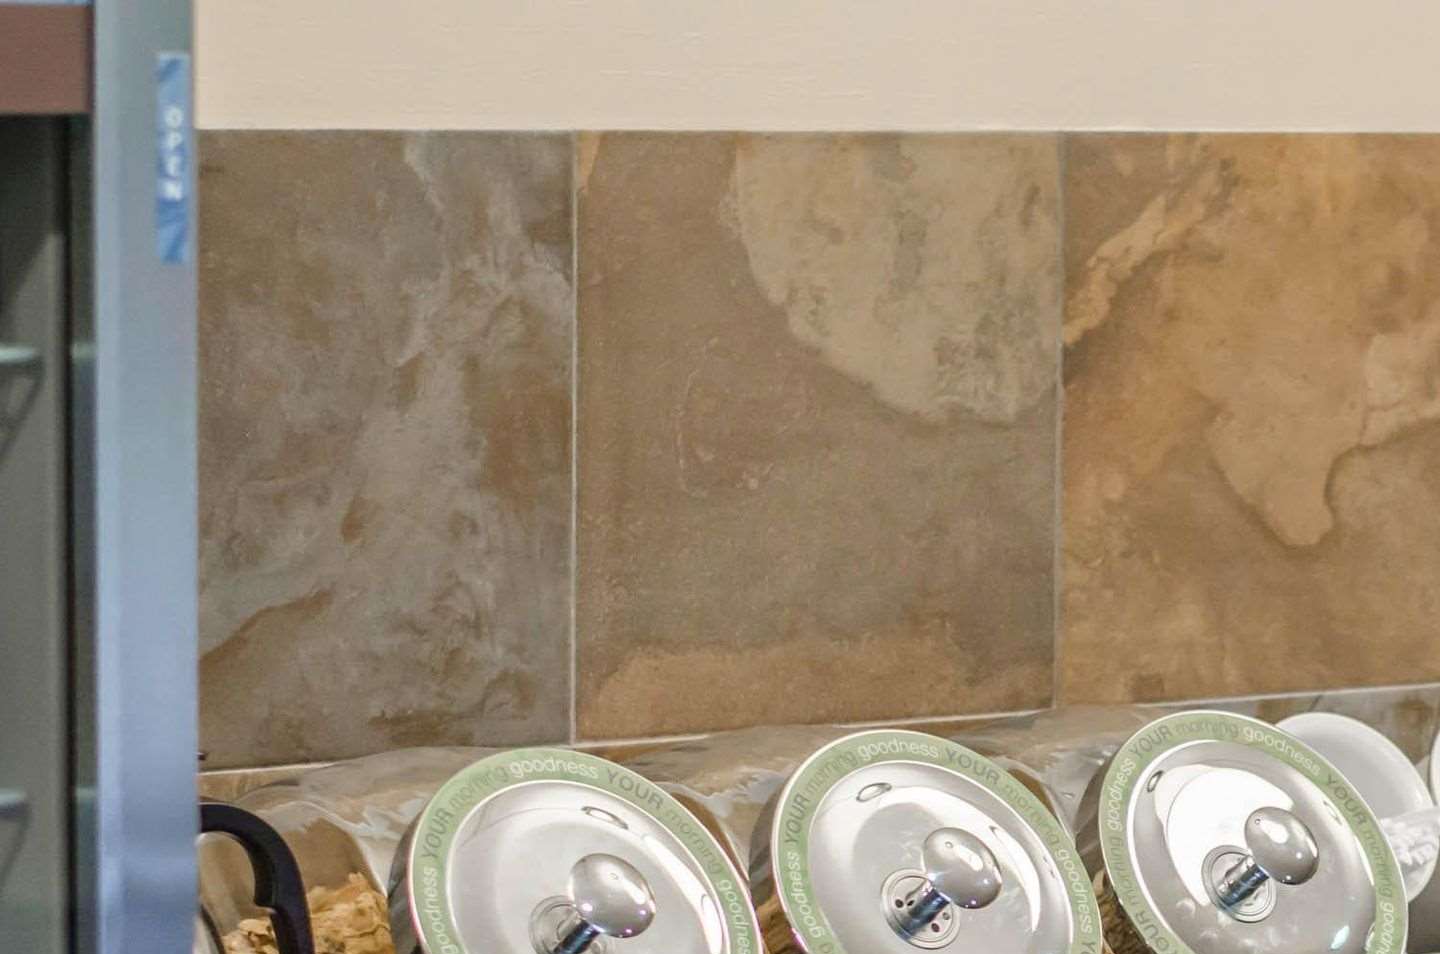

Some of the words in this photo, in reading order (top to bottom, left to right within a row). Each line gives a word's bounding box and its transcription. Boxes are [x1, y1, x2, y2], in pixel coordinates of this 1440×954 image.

[607, 768, 664, 809] YOUR
[1128, 724, 1172, 756] YOUR
[1242, 725, 1320, 775] goodness
[421, 807, 454, 859] YOUR
[510, 756, 599, 779] goodness
[785, 793, 808, 845] YOUR
[858, 739, 939, 760] goodness
[1106, 758, 1137, 831] goodness
[1325, 774, 1367, 825] YOUR
[945, 747, 1000, 785] YOUR
[1055, 849, 1093, 934] goodness
[786, 851, 826, 938] goodness
